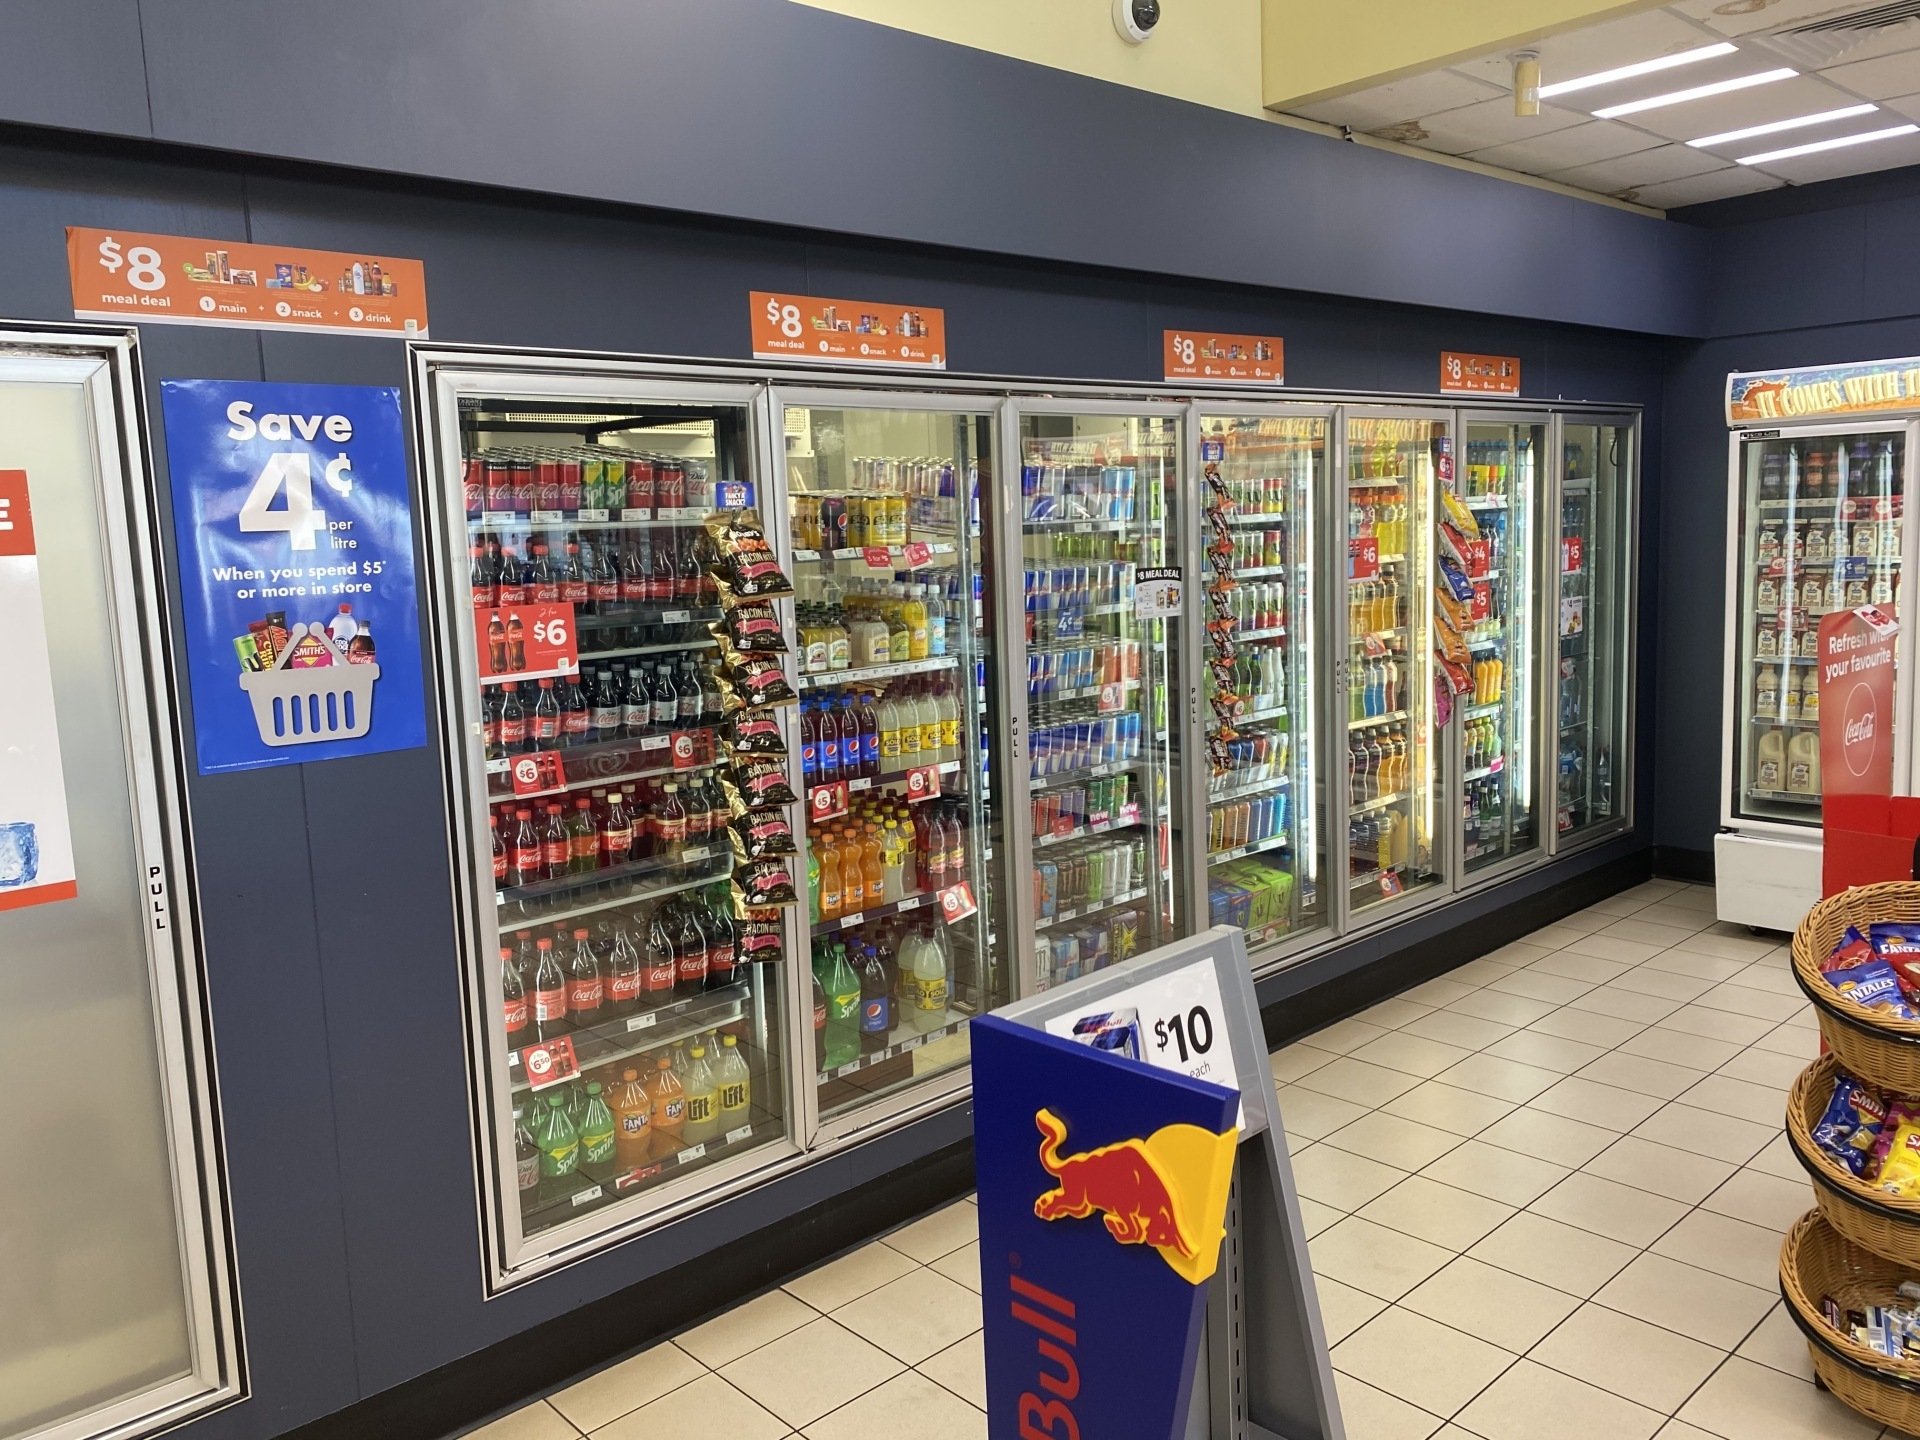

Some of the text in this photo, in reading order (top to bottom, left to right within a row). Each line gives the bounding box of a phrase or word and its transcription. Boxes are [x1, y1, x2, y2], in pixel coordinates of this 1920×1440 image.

[99, 236, 167, 291] $8
[102, 293, 171, 308] meal deal
[218, 303, 248, 314] main
[292, 308, 323, 319] snack
[365, 313, 392, 324] drink
[766, 297, 803, 338] $8
[768, 340, 805, 350] meal deal
[1173, 334, 1196, 365] $8
[1446, 355, 1462, 380] $8
[1754, 389, 1777, 419] IT
[1779, 379, 1843, 416] COMES
[1843, 369, 1901, 406] WITH
[226, 400, 354, 441] Save
[329, 519, 354, 535] per
[330, 536, 357, 551] litre
[1570, 545, 1580, 559] $5
[1363, 547, 1376, 564] $6
[212, 566, 266, 582] When
[270, 568, 304, 583] you
[308, 561, 358, 580] spend
[1145, 569, 1164, 579] MEAL
[1163, 569, 1180, 578] DEAL
[237, 581, 373, 599] or more in store
[1476, 591, 1487, 607] $5
[533, 618, 568, 645] $6
[293, 646, 326, 657] SMITH'S
[1829, 632, 1868, 655] Refresh
[1825, 649, 1892, 684] your favourite
[1011, 716, 1020, 758] PULL
[1845, 712, 1875, 746] Coca-Cola
[678, 744, 691, 755] $6
[519, 767, 535, 780] $6
[912, 779, 921, 788] $5
[817, 796, 828, 806] $5
[149, 866, 166, 930] PULL
[1841, 978, 1895, 1001] ANTALES
[1154, 1005, 1213, 1063] $10
[1188, 1061, 1211, 1078] each
[722, 1084, 745, 1109] Lift
[687, 1096, 710, 1122] Lift
